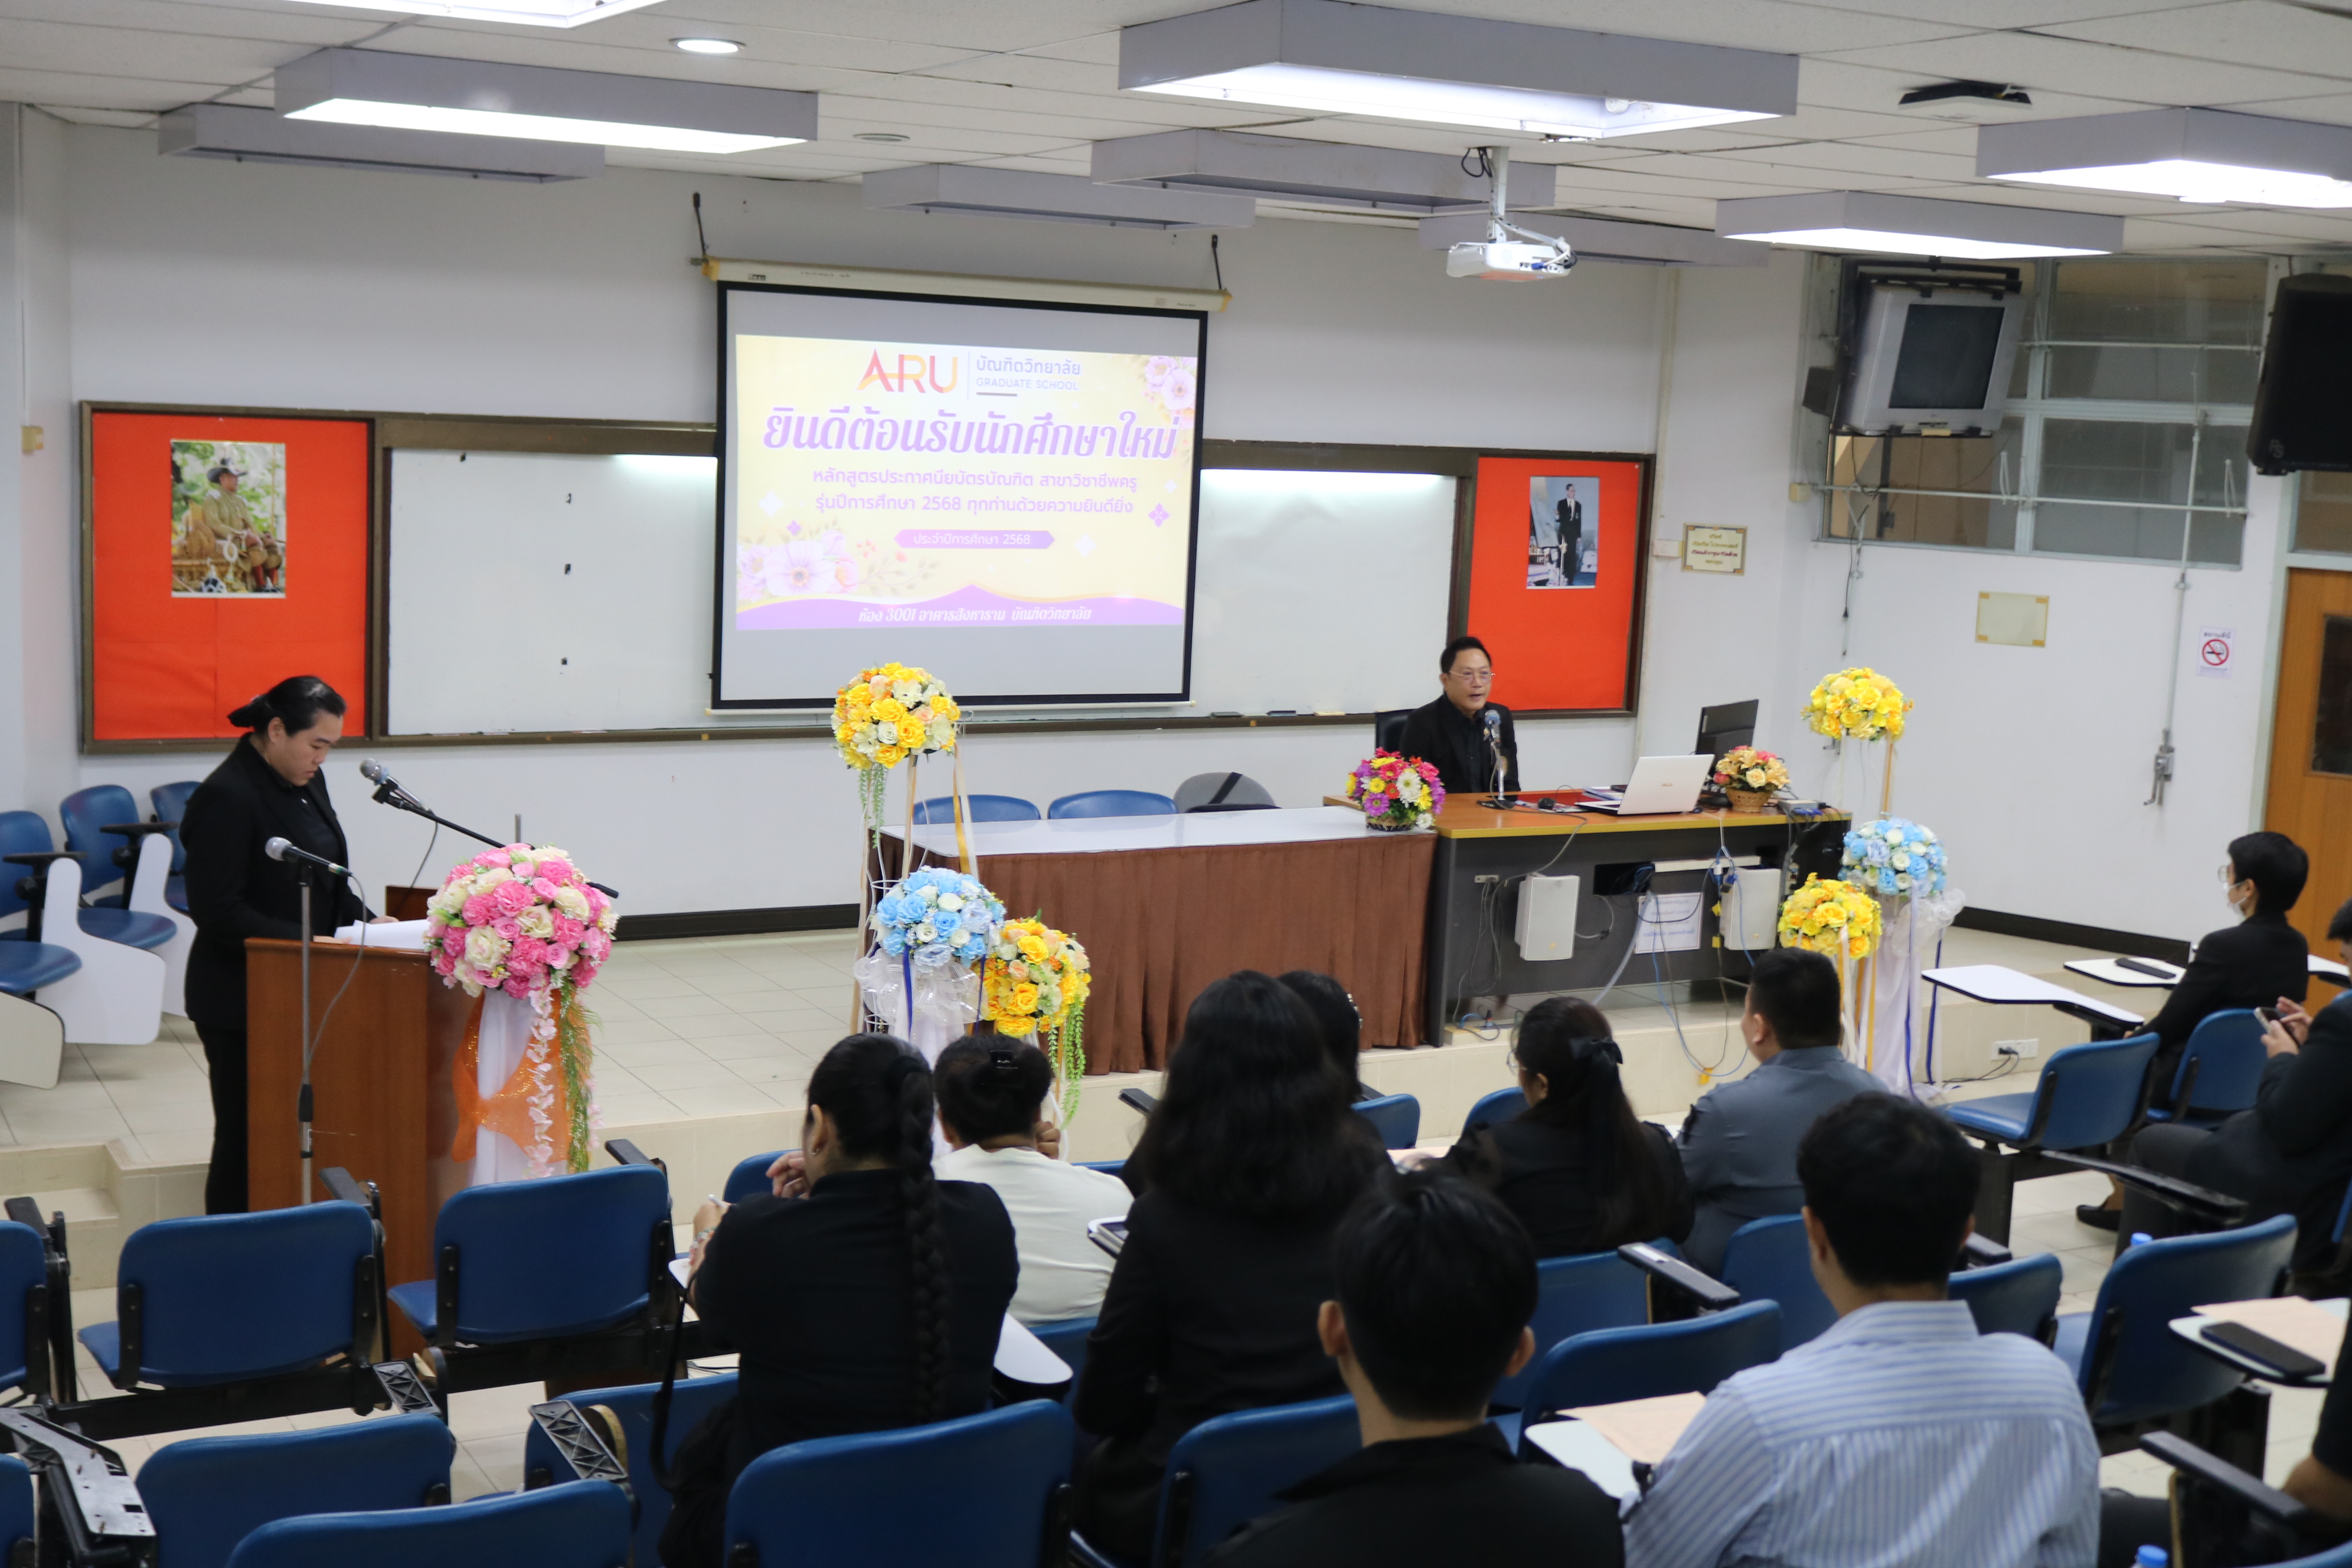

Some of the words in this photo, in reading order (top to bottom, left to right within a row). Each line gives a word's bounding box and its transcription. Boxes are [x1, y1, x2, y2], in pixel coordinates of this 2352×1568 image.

[855, 347, 958, 394] ARU
[976, 354, 1081, 375] บัณฑิตวิทยาลัย
[976, 377, 1031, 388] GRADUATE
[1035, 380, 1079, 391] SCHOOL
[763, 405, 1180, 459] ยินดีต้อนรับนักศึกษาใหม่
[813, 466, 1034, 488] หลักสูตรประกาศนียบัตรบัณฑิต
[1039, 472, 1138, 493] สาขาวิชาชีพครู
[815, 492, 916, 514] รุ่นปีการศึกษา
[921, 495, 961, 511] 2568
[967, 495, 1133, 516] ทุกท่านด้วยความยินดียิ่ง
[913, 532, 998, 545] ประจำปีการศึกษา
[1002, 534, 1030, 545] 2568
[858, 607, 883, 622] ห้อง
[885, 607, 917, 622] 3001
[918, 607, 1006, 622] อาคารสิงหาราม
[1011, 606, 1092, 620] บัณฑิตวิทยาลัย
